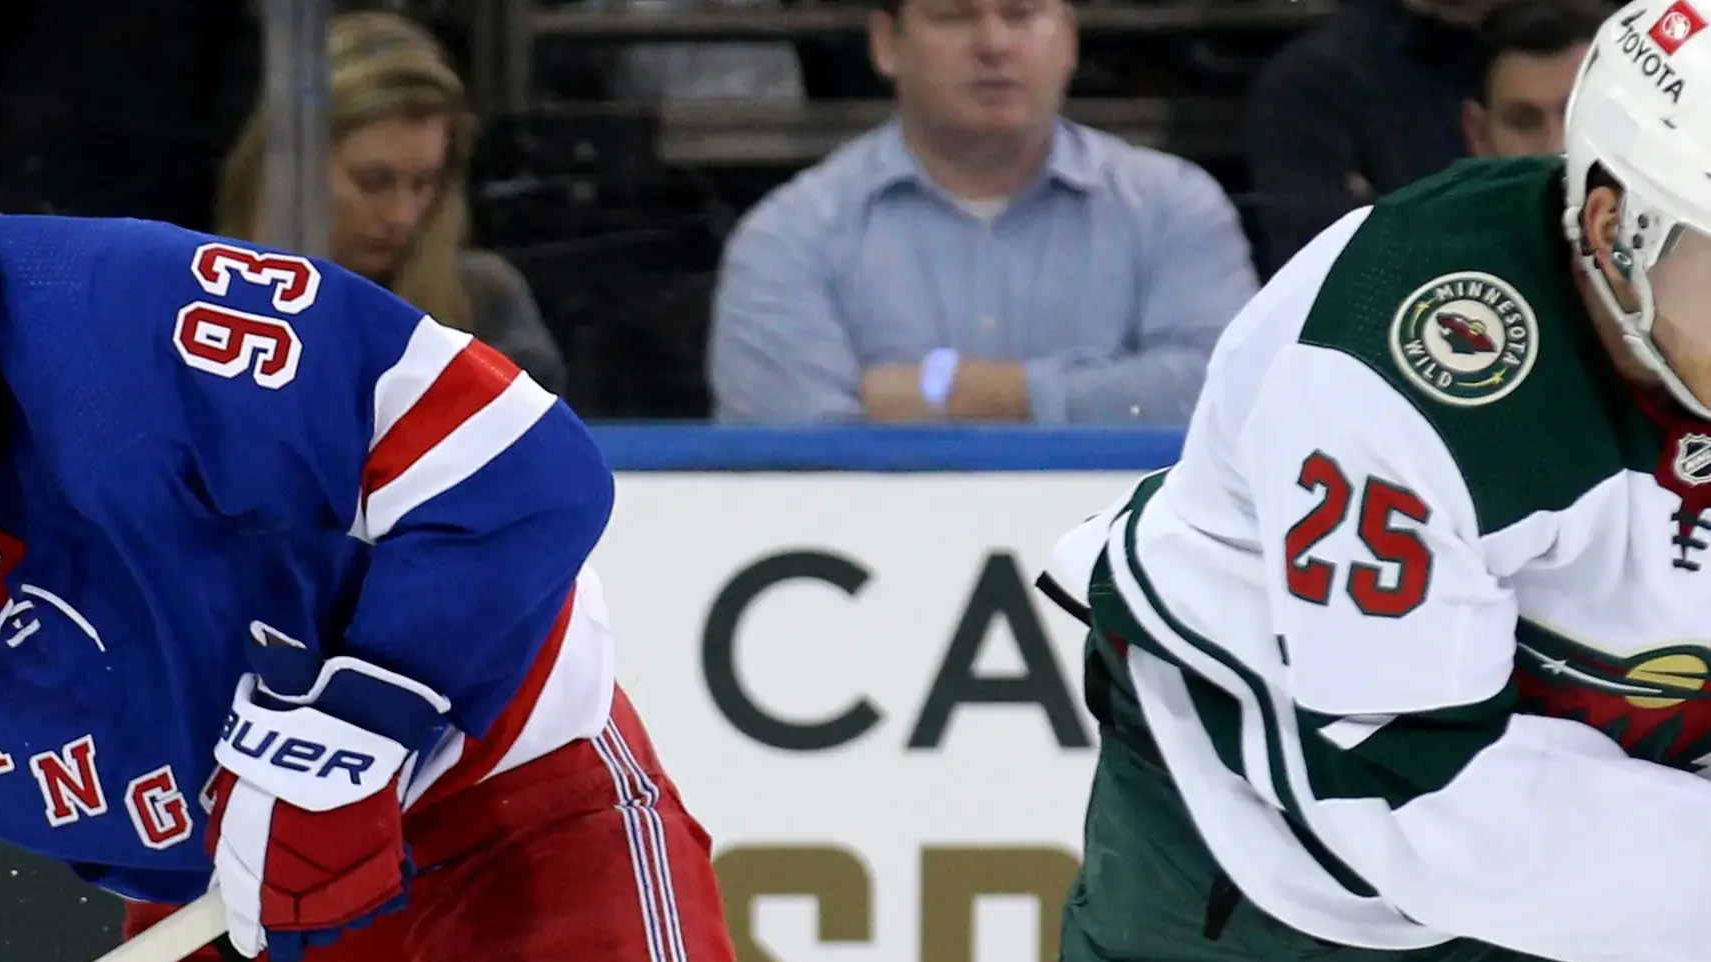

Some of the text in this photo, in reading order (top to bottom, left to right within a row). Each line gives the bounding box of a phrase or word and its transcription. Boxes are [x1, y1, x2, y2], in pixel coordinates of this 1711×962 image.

[1616, 25, 1686, 104] TOYOTA
[173, 242, 322, 390] 93
[1404, 339, 1454, 388] WILD
[1434, 281, 1527, 366] MINNESOTA
[1285, 447, 1436, 619] 25
[699, 546, 1097, 752] CA
